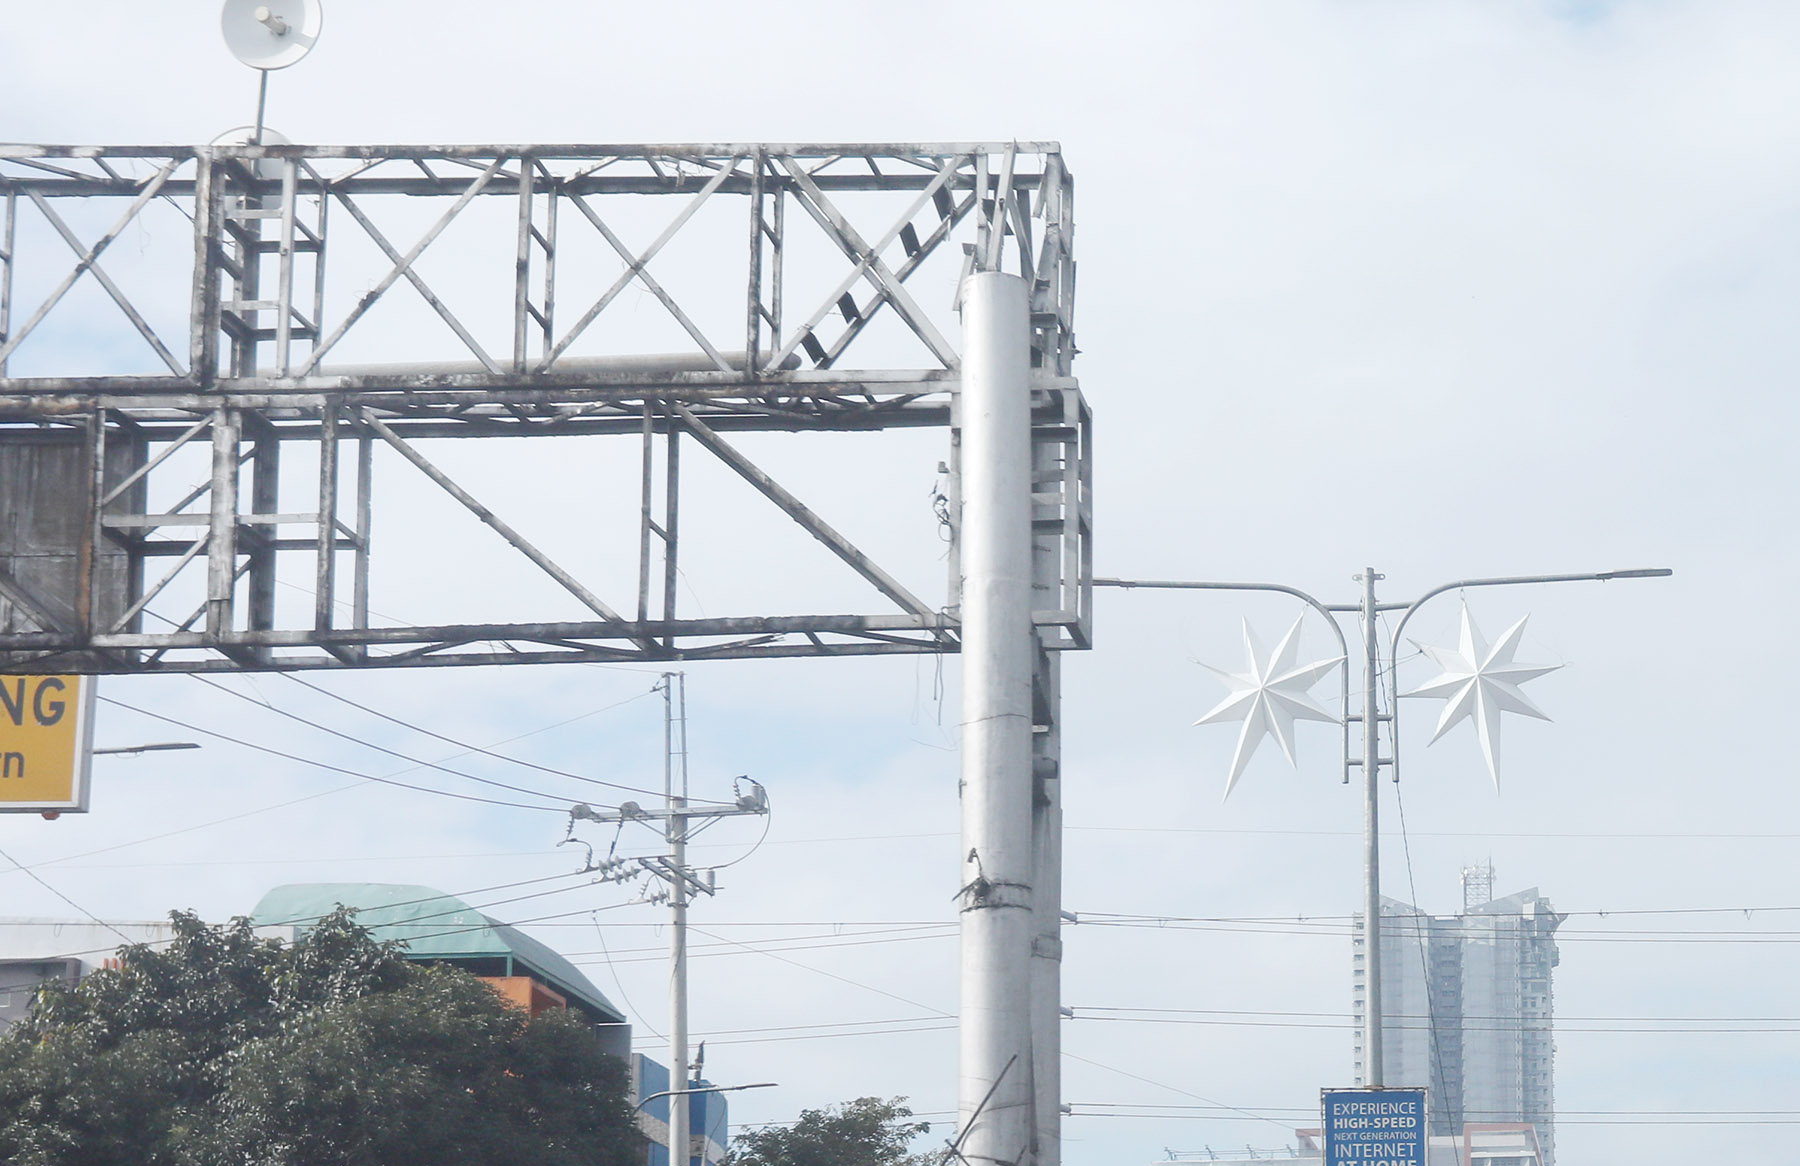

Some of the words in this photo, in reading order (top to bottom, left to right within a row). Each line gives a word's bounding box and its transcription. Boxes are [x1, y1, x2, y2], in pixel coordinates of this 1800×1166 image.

[1333, 1102, 1417, 1115] EXPERIENCE
[1334, 1117, 1417, 1129] HIGH-SPEED
[1334, 1133, 1357, 1141] NEXT
[1360, 1131, 1417, 1140] GENERATION
[1335, 1143, 1417, 1158] INTERNET
